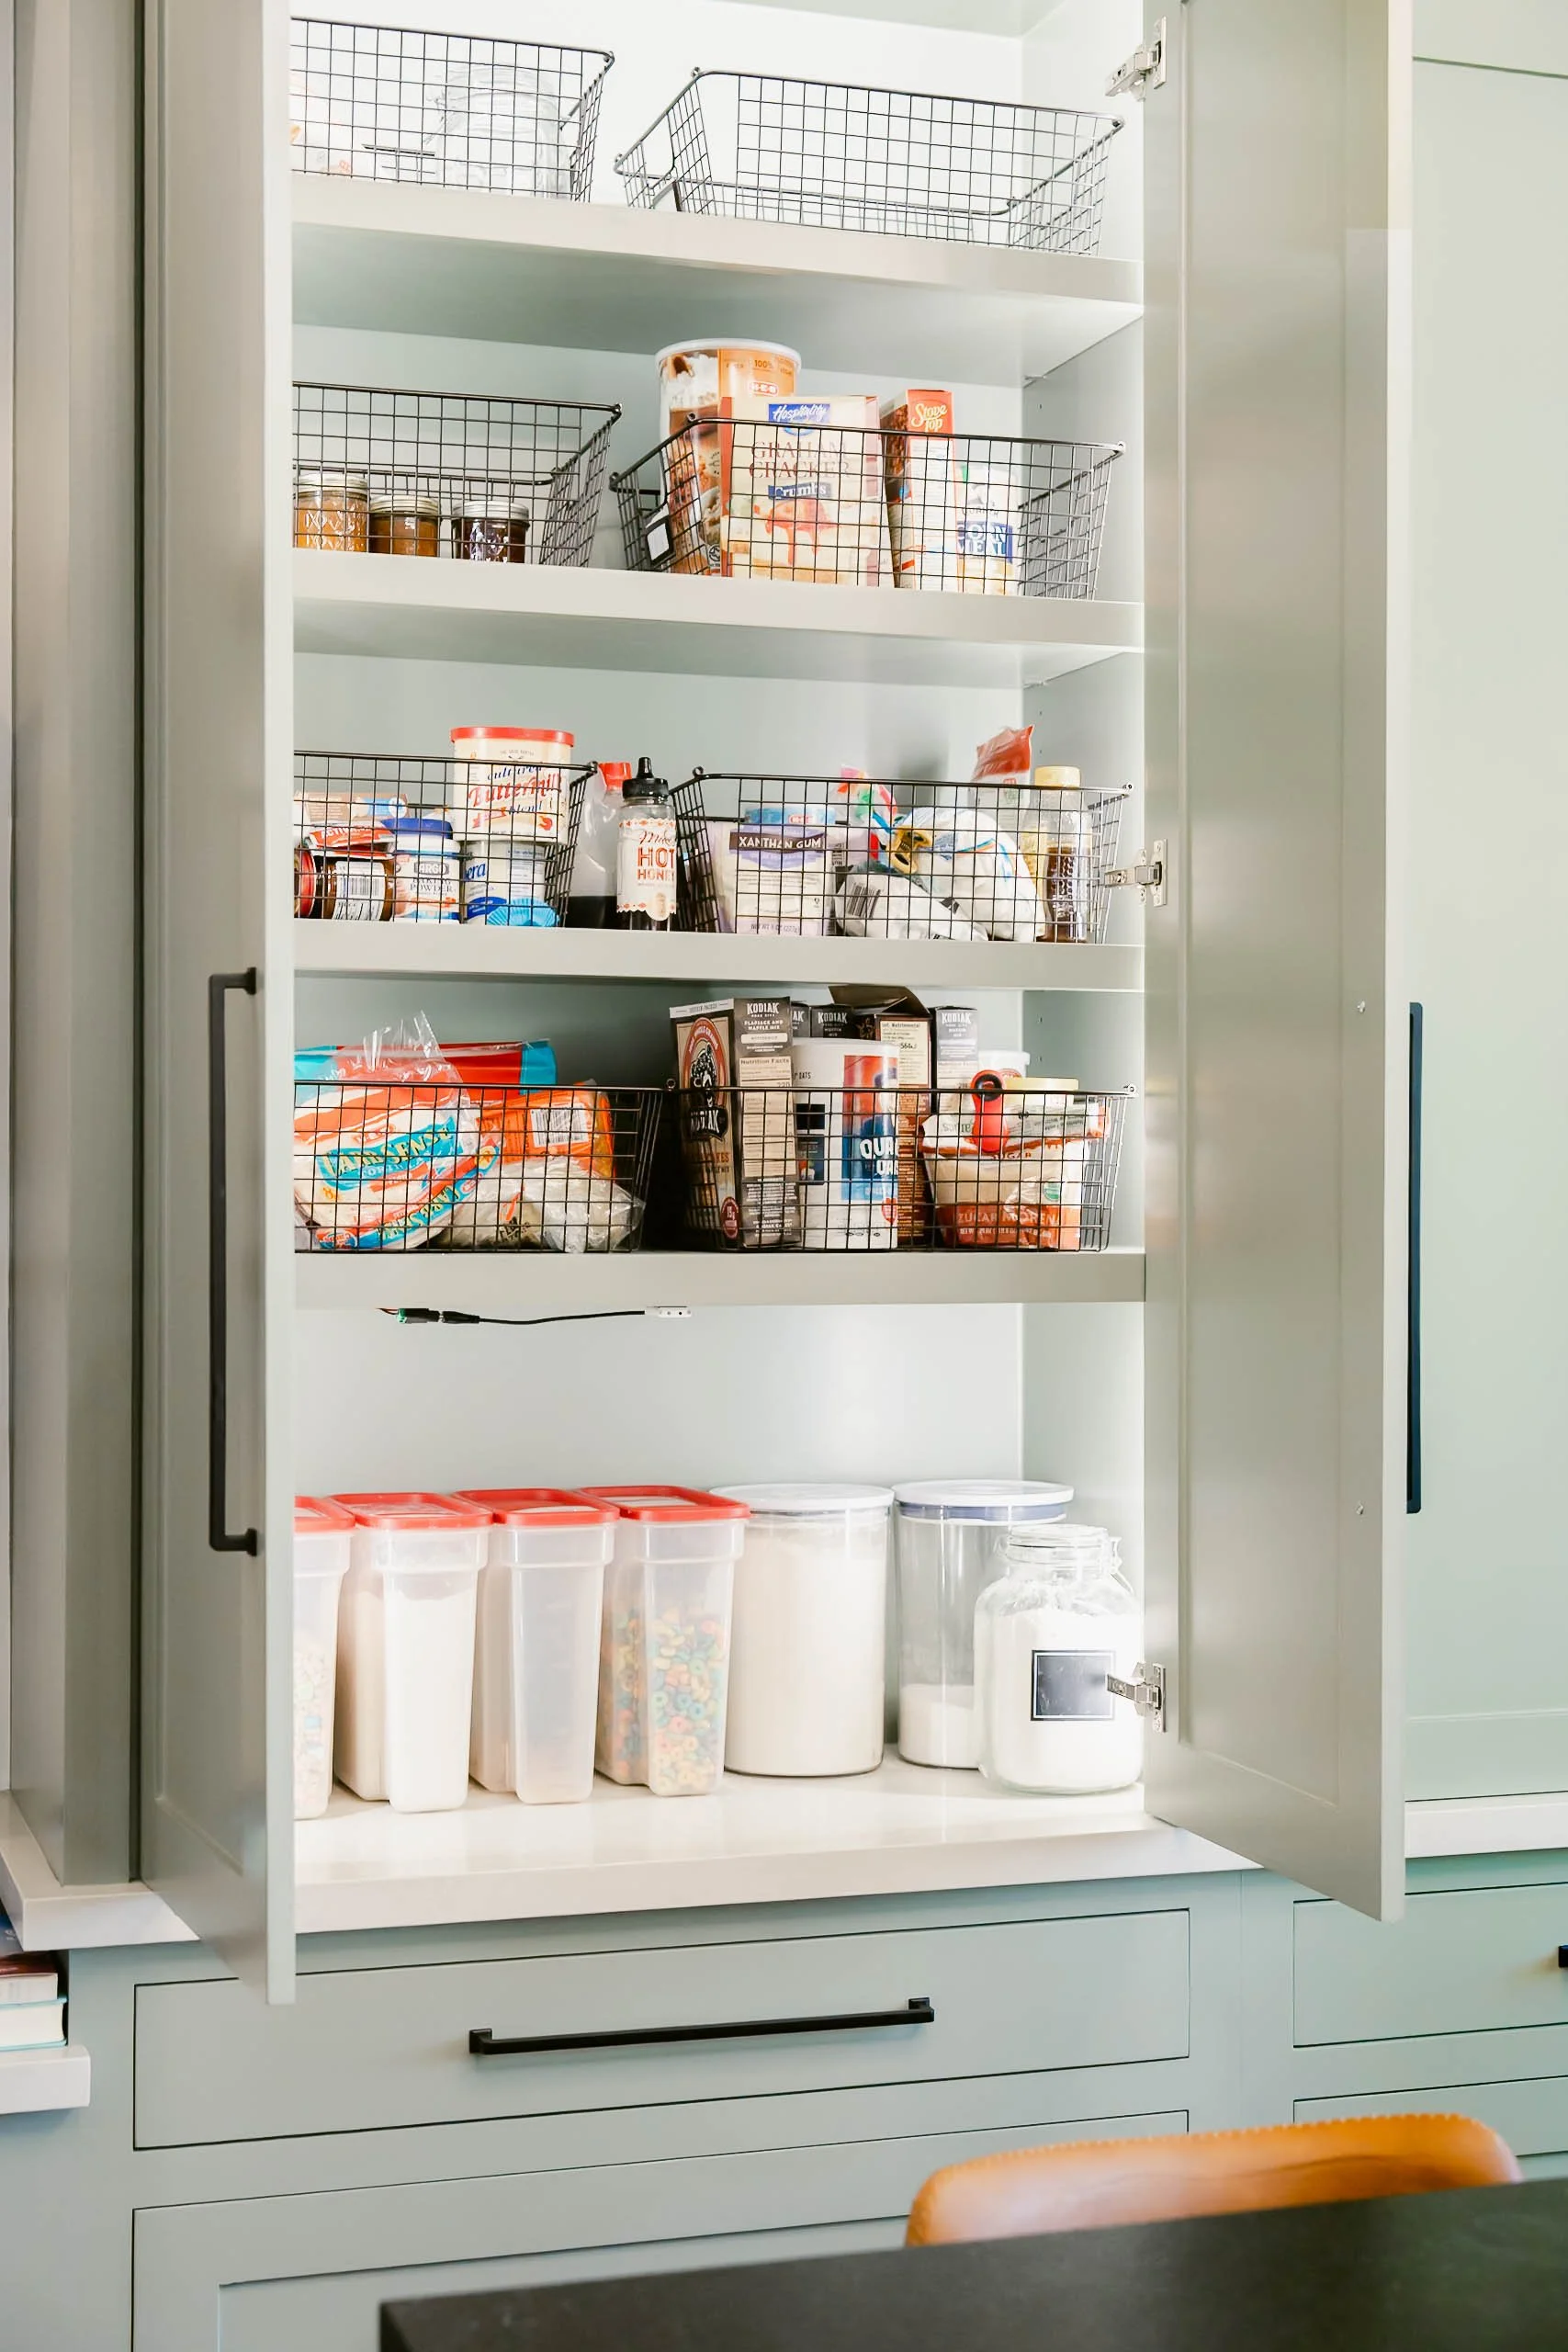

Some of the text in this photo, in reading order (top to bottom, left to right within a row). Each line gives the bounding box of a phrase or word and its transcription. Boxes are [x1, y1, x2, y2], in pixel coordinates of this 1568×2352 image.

[773, 403, 827, 422] Hospitality
[910, 403, 947, 427] Stove
[924, 418, 943, 433] Top
[750, 441, 849, 458] GRAHAM
[749, 461, 851, 479] CRACKER
[774, 481, 827, 500] Crumbs
[739, 836, 821, 849] XANTHAN GUM
[637, 846, 675, 869] HOT
[419, 864, 447, 875] ARGO
[747, 1002, 780, 1015] KODIAK
[818, 1012, 848, 1024] KODIAK
[942, 1012, 972, 1024] KODIAK
[798, 1071, 811, 1080] OATS
[859, 1136, 898, 1159] QUA
